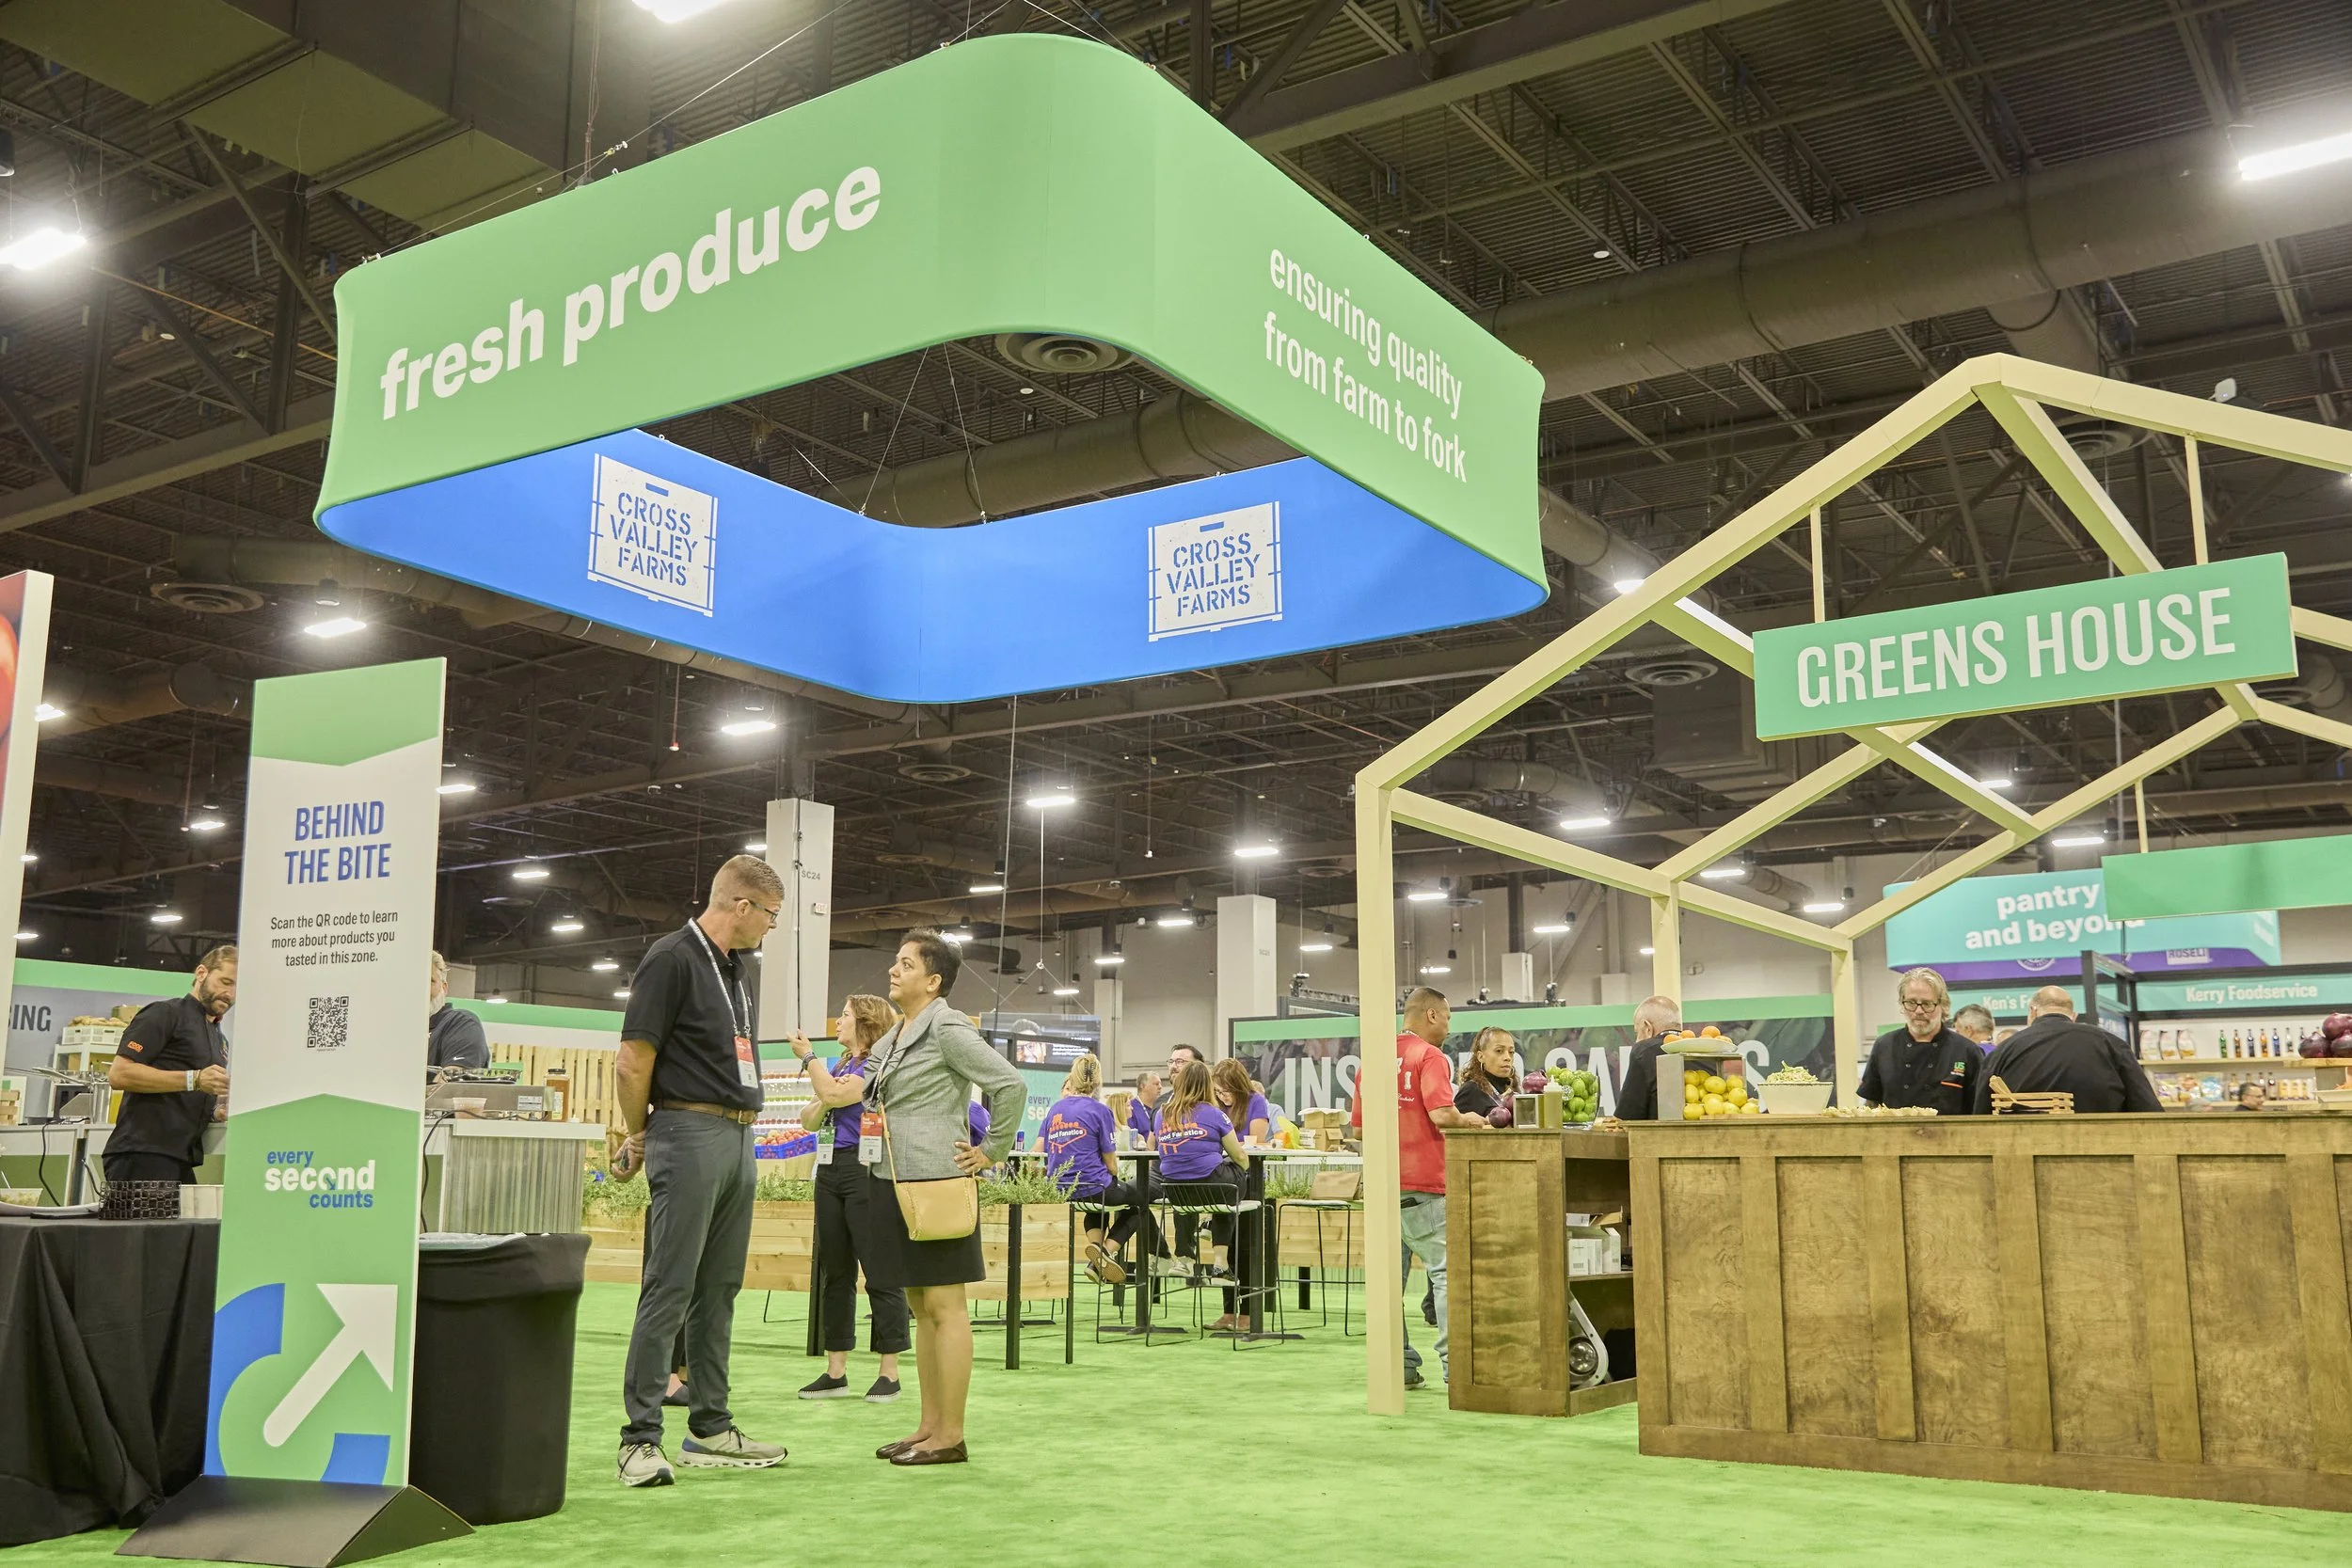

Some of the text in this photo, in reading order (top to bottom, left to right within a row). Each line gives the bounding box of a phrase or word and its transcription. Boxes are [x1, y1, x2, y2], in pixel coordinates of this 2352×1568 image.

[380, 166, 882, 420] fresh produce
[1270, 249, 1462, 420] ensuring quality
[1264, 310, 1467, 483] from farm to fork
[618, 492, 691, 536] CROSS
[610, 515, 698, 562] VALLEY
[1173, 532, 1251, 568] CROSS
[617, 546, 687, 587] FARMS
[1167, 554, 1261, 594] VALLEY
[1177, 584, 1250, 617] FARMS
[1797, 588, 2235, 707] GREENS HOUSE
[294, 800, 385, 841] BEHIND
[284, 843, 392, 884] THE BITE
[801, 870, 821, 880] SC24
[1996, 883, 2101, 921] pantry
[270, 911, 398, 930] Scan the QR code to learn
[1965, 921, 2022, 949] and
[271, 930, 395, 948] more about products you
[285, 950, 378, 966] tasted in this zone.
[1982, 995, 2018, 1011] Ken's
[2185, 983, 2318, 1005] Kerry Foodservice
[9, 1004, 52, 1032] ING
[1028, 1095, 1051, 1107] every
[267, 1150, 314, 1167] every
[264, 1160, 375, 1192] second
[310, 1190, 373, 1209] counts
